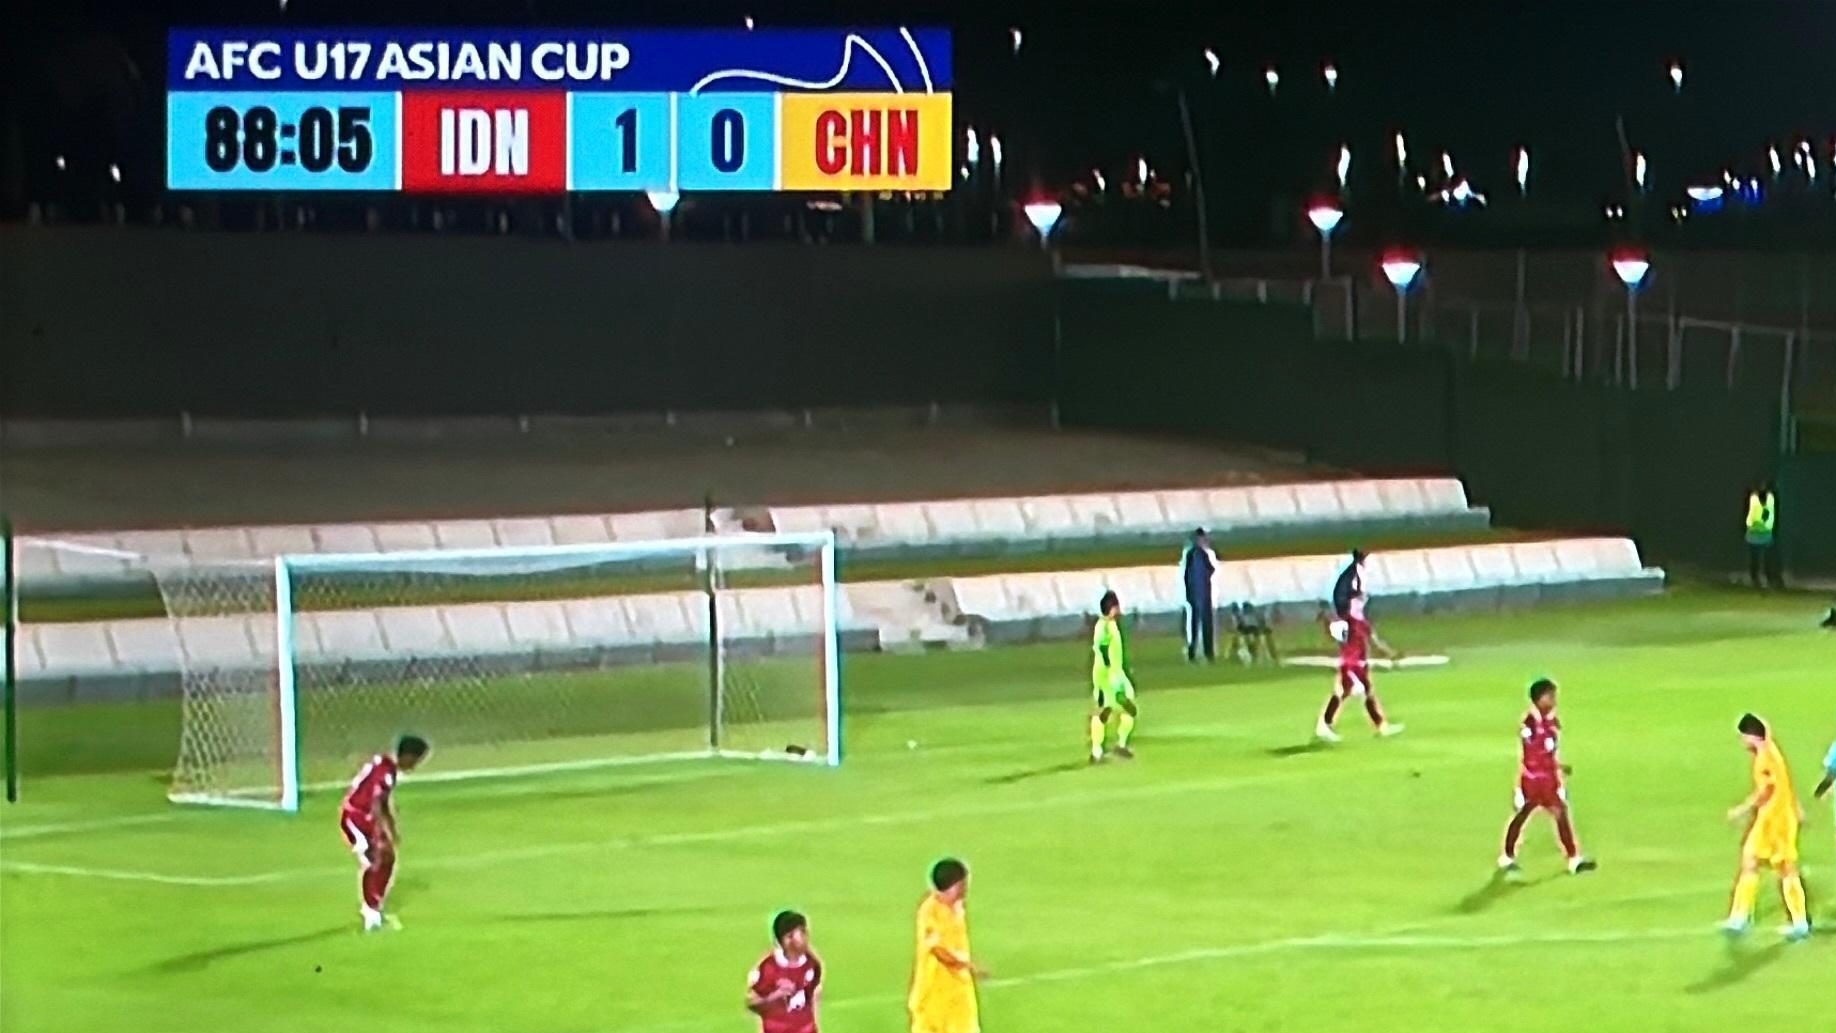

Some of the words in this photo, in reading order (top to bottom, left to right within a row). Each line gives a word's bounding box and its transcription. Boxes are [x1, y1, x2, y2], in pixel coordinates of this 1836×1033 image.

[184, 41, 282, 80] AFC
[295, 41, 372, 80] U17
[375, 41, 521, 80] ASIAN
[530, 42, 630, 80] CUP
[204, 105, 373, 173] 88:05
[440, 108, 529, 176] IDN
[615, 108, 637, 173] 1
[711, 108, 744, 173] 0
[815, 108, 919, 176] CHN
